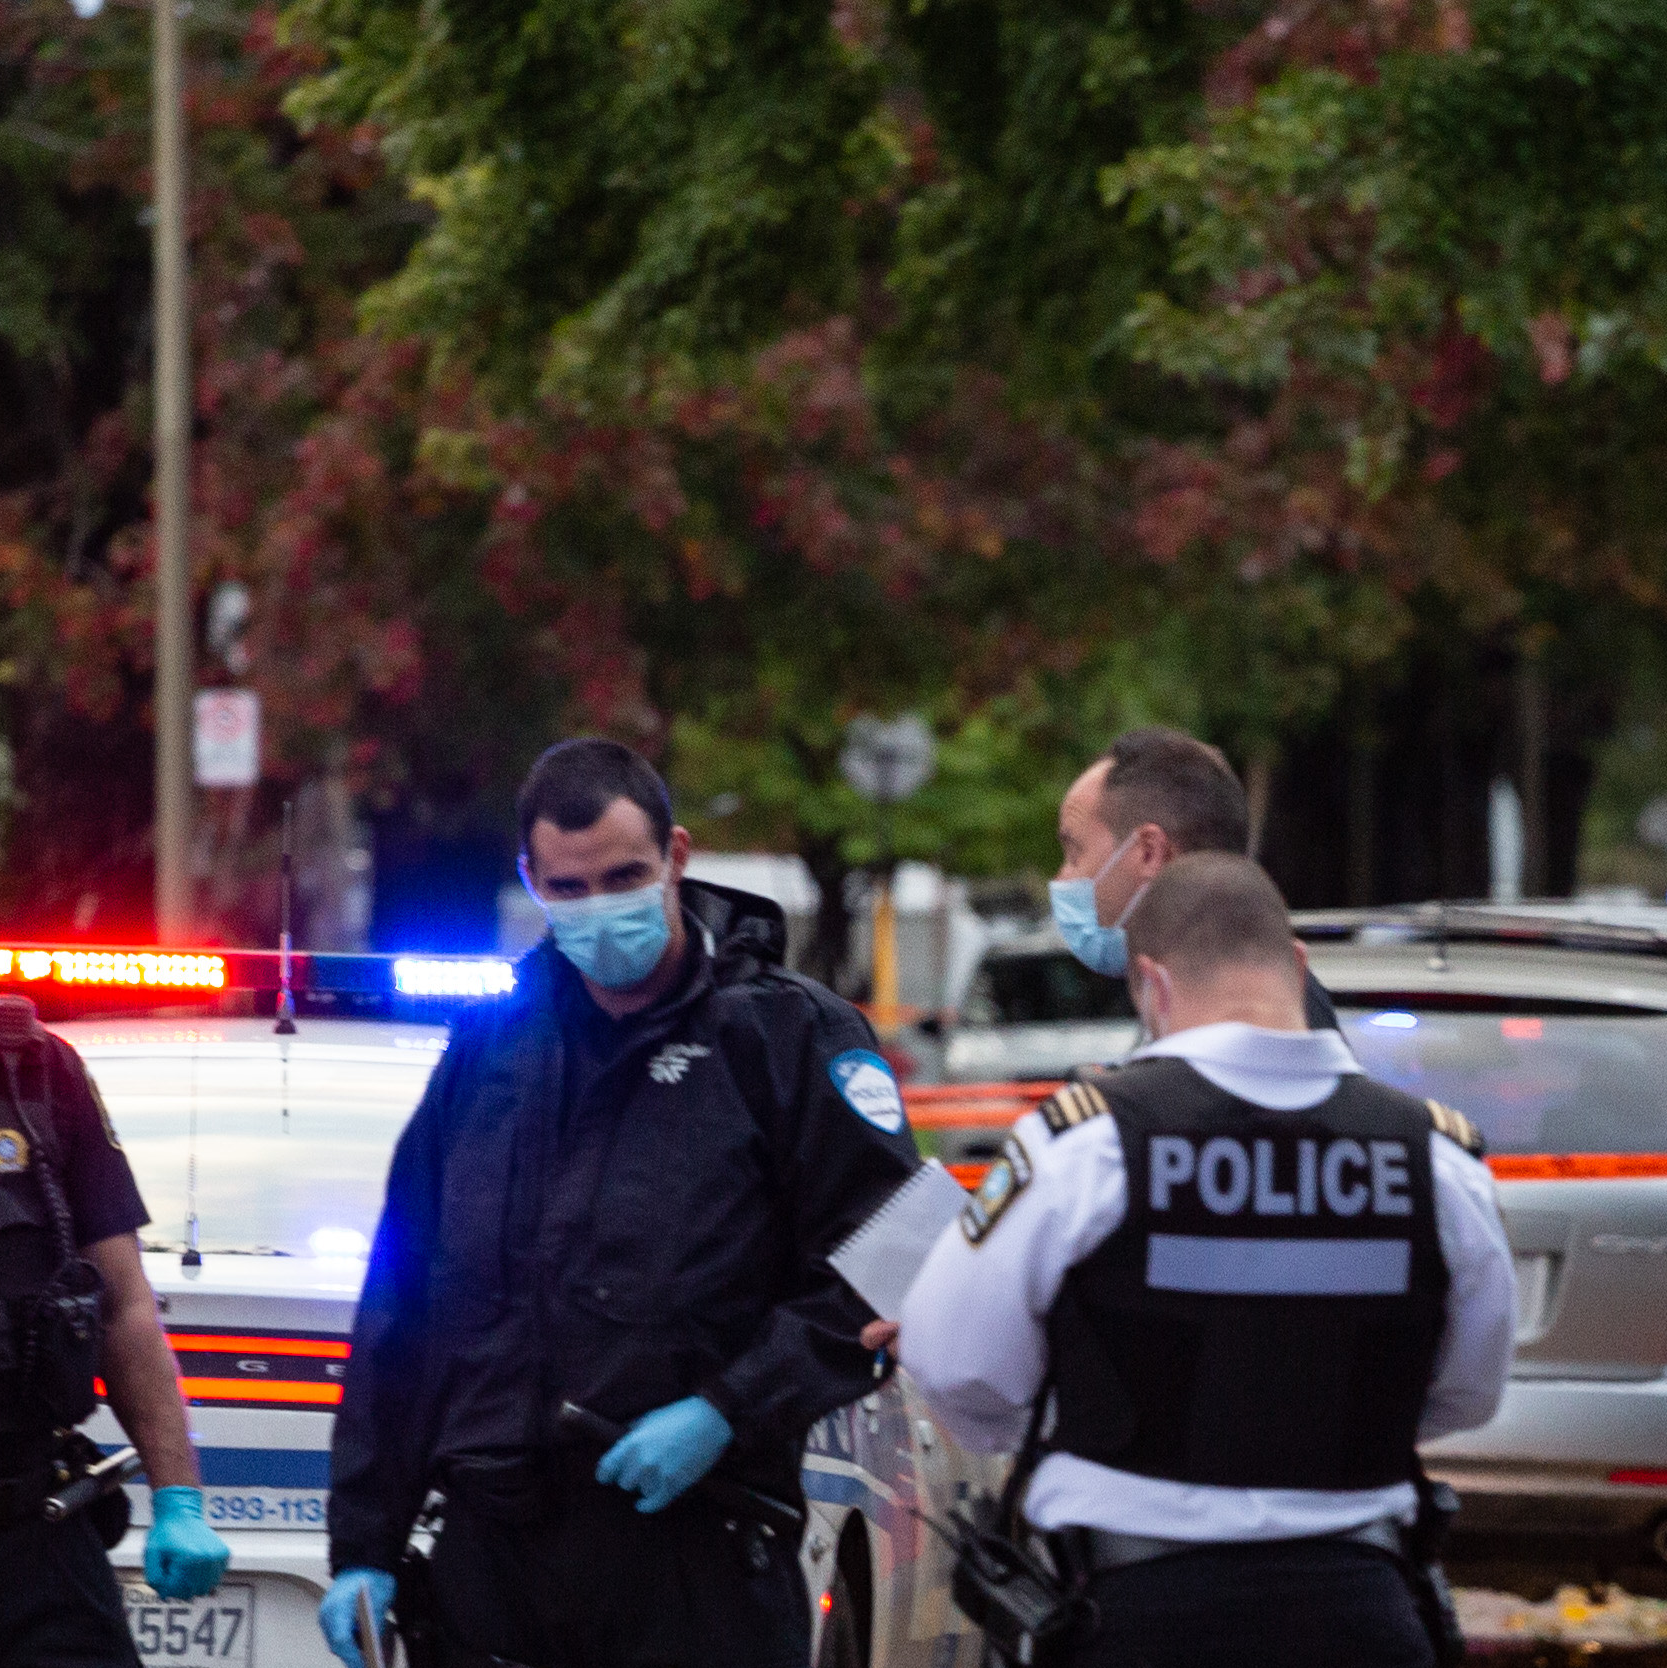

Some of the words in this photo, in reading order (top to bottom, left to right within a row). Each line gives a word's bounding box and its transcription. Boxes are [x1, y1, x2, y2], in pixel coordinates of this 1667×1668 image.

[1148, 1135, 1414, 1218] POLICE
[209, 1496, 329, 1522] 393-113
[125, 1606, 244, 1656] 5547
